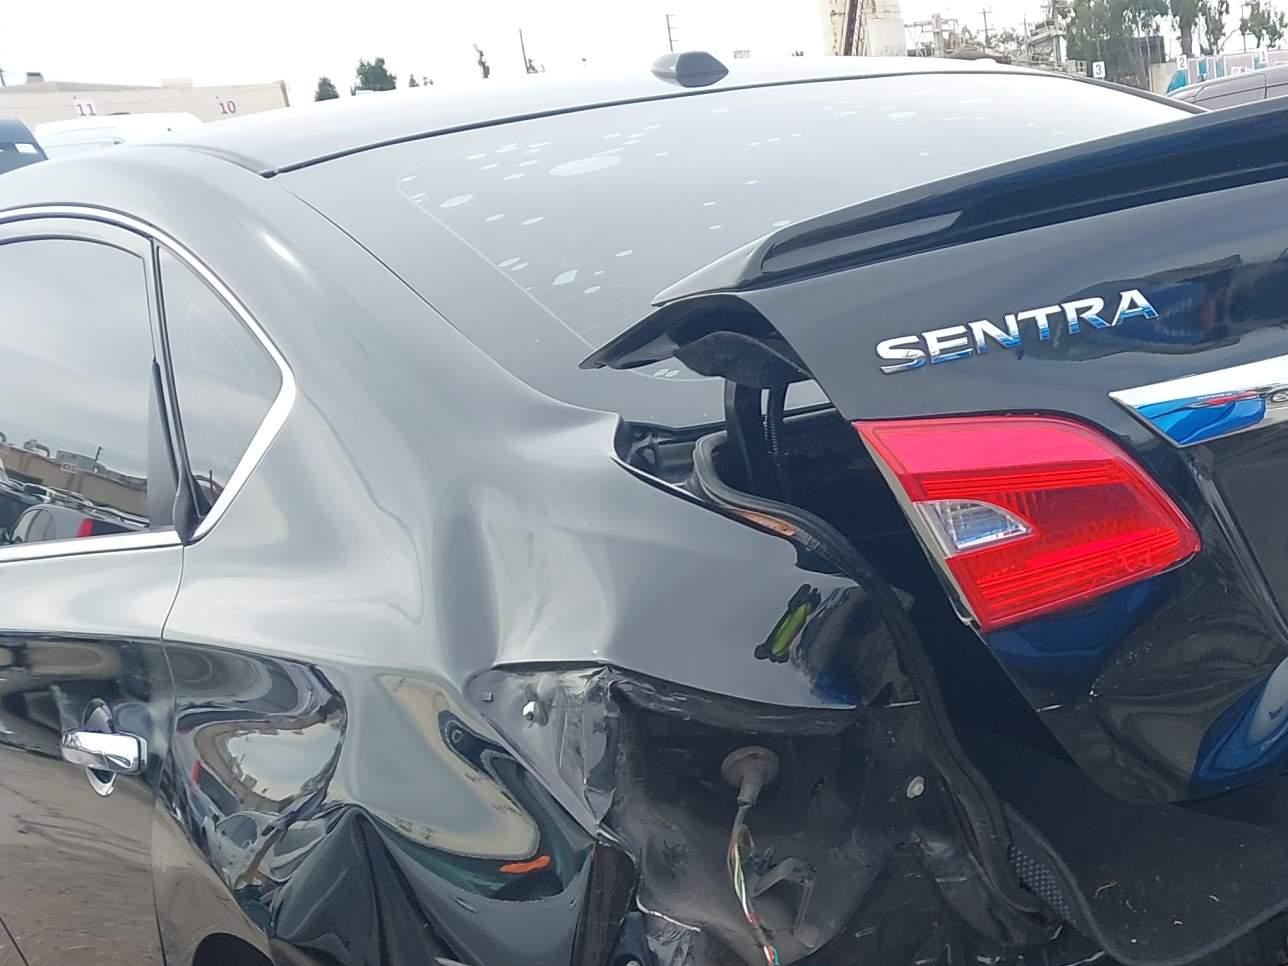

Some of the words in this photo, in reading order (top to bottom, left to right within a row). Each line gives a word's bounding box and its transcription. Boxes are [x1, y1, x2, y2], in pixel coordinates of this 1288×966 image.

[1095, 64, 1103, 76] 3
[77, 103, 96, 117] 11
[218, 100, 237, 115] 10
[875, 288, 1159, 374] SENTRA
